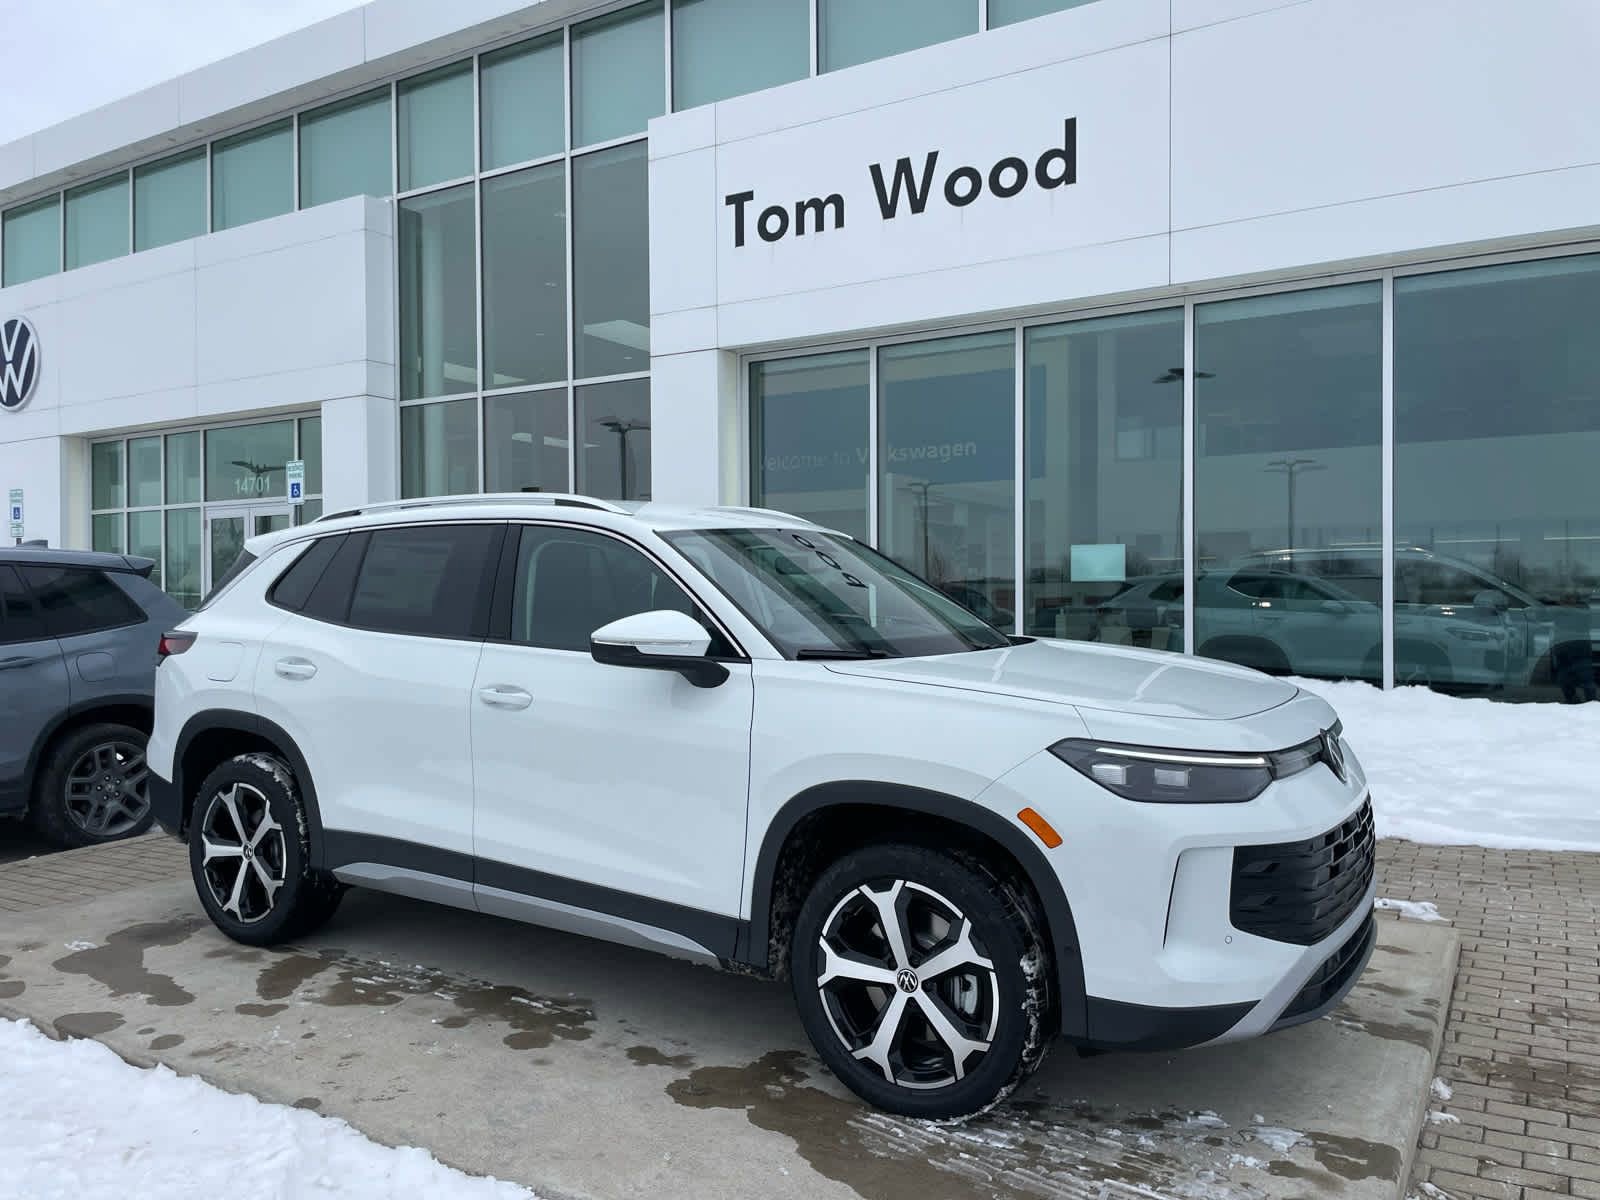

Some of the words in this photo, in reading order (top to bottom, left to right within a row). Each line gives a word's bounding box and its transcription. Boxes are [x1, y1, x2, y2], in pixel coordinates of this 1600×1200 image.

[725, 190, 845, 248] Tom
[868, 116, 1077, 220] Wood
[855, 441, 977, 464] Vkswagen
[234, 475, 270, 495] 14701
